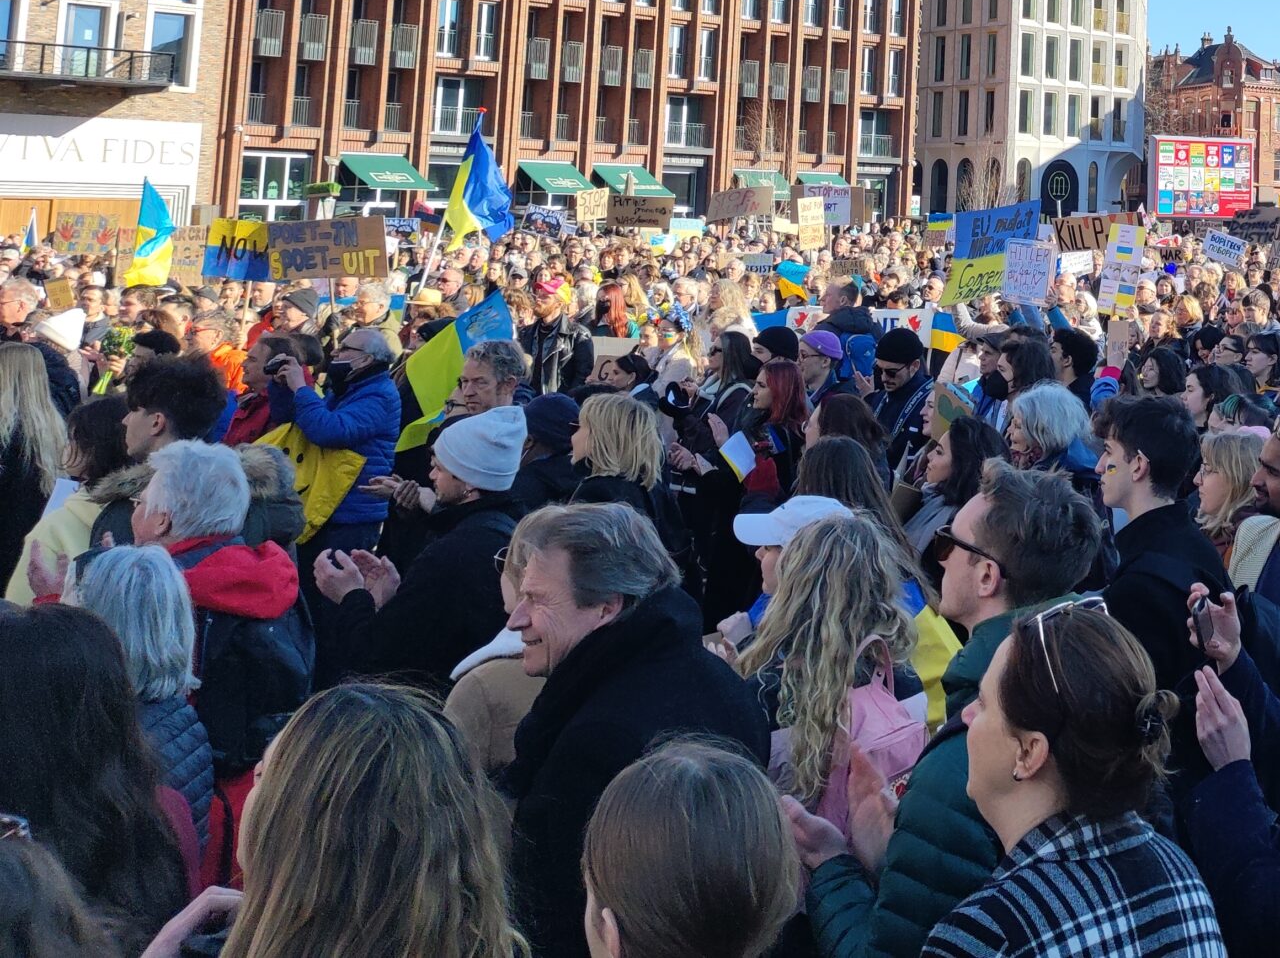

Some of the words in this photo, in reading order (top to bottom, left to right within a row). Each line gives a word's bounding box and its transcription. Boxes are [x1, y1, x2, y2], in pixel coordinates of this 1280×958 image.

[101, 138, 195, 166] FIDES
[579, 190, 605, 206] STOP
[807, 186, 833, 198] STOP
[216, 234, 247, 266] NO
[1160, 248, 1182, 261] WAR
[269, 248, 381, 281] SPOET-UIT
[745, 264, 773, 274] RESIST
